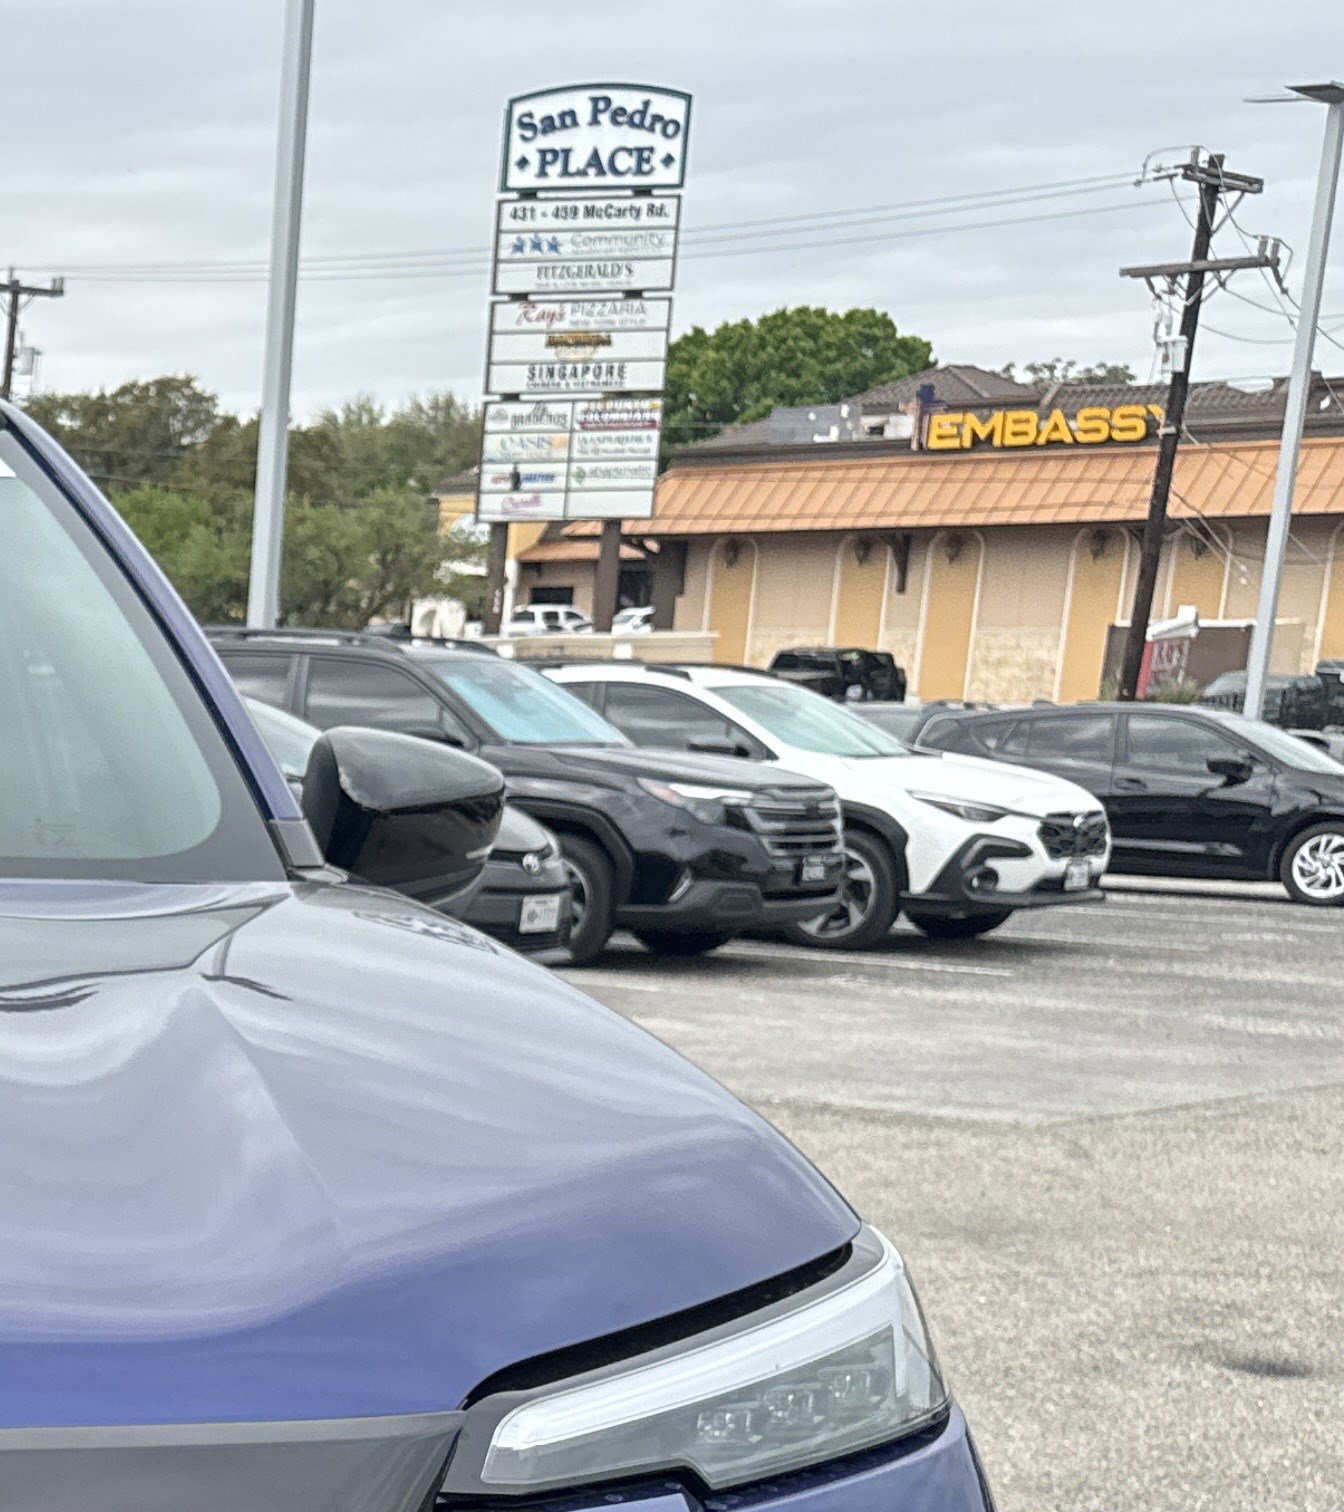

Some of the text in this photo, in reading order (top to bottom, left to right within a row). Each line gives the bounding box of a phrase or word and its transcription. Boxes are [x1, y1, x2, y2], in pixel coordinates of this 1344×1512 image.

[516, 95, 681, 143] San Pedro
[534, 146, 655, 178] PLACE
[510, 205, 537, 221] 431
[583, 203, 642, 222] McCarty
[569, 231, 666, 249] Community
[535, 262, 635, 282] FITZGERALD'S
[526, 363, 628, 382] SINGAPORE
